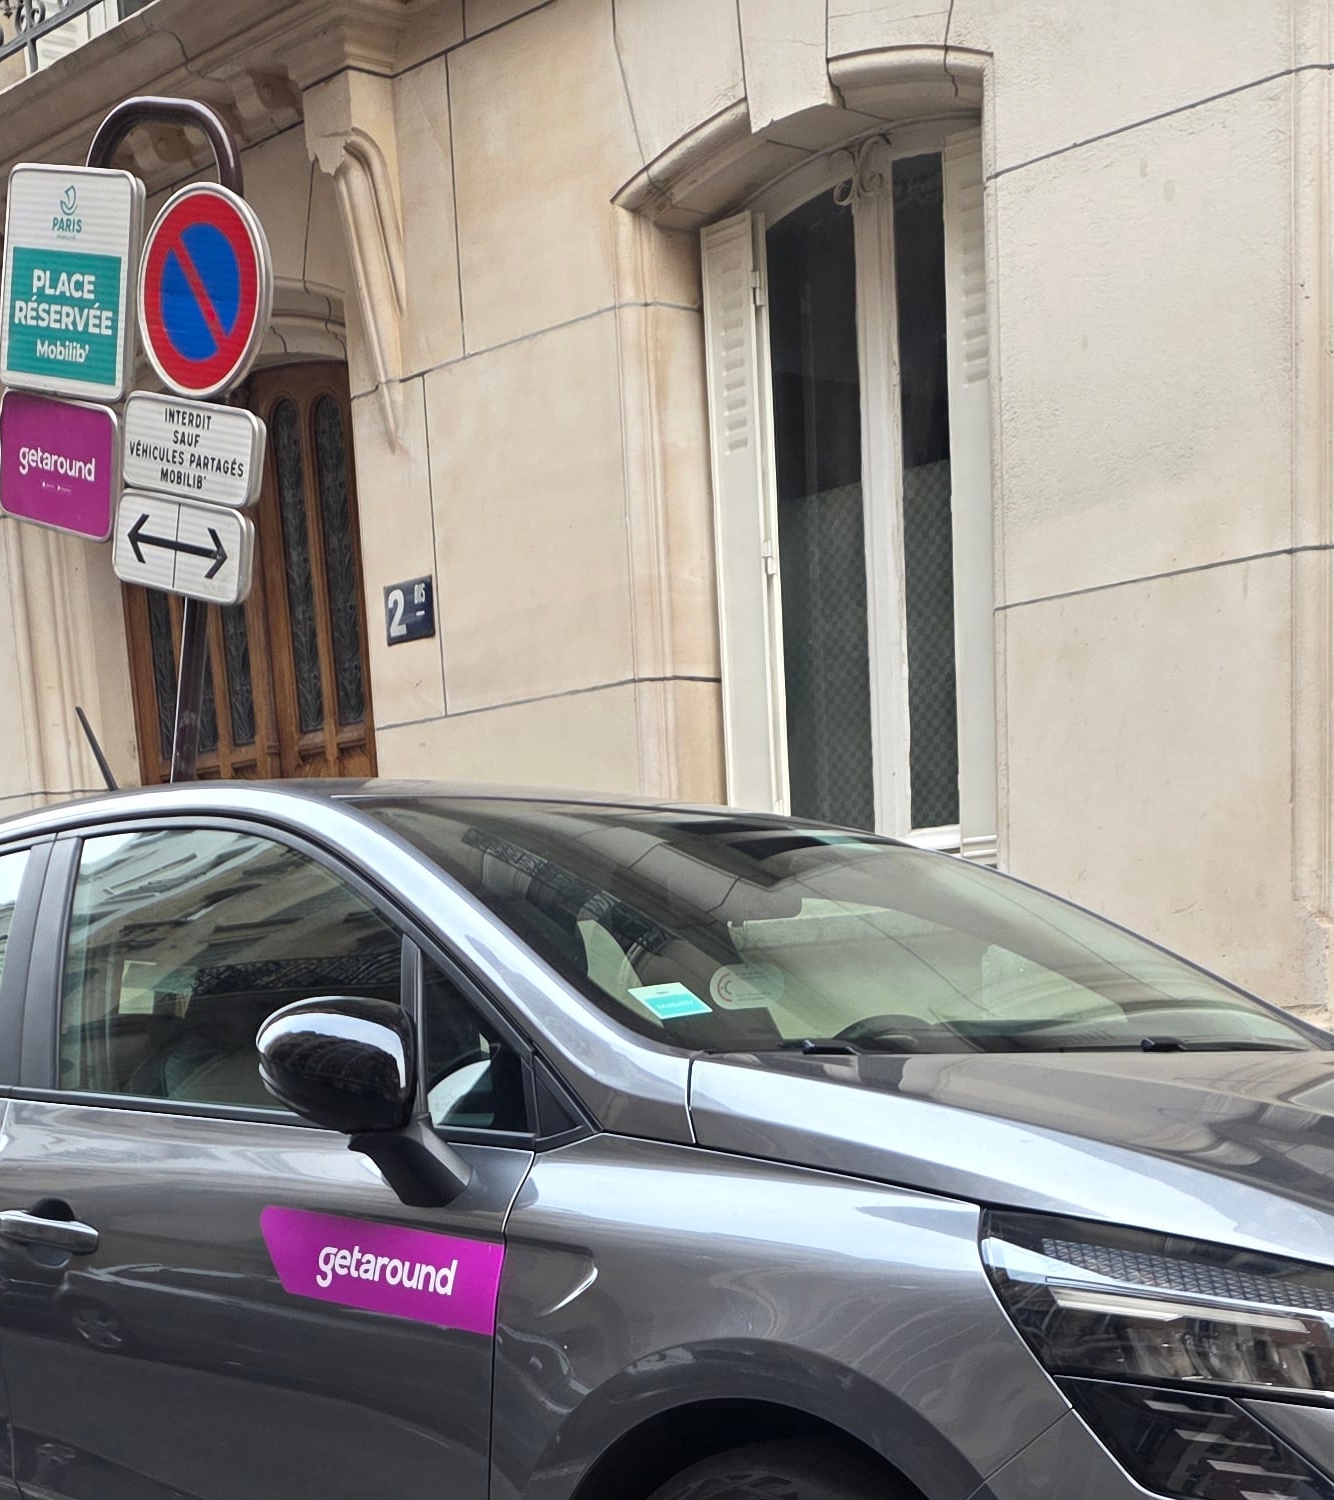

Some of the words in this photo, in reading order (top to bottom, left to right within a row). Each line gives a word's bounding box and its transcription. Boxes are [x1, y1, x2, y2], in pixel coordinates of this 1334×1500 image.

[52, 216, 83, 234] PARIS
[32, 268, 96, 300] PLACE
[14, 295, 113, 336] RÉSERVÉE
[164, 407, 212, 431] INTERDIT
[172, 429, 201, 448] SAUF
[19, 446, 96, 482] getaround
[129, 440, 185, 466] VÉHICULES
[189, 453, 244, 478] PARTAGÉS
[388, 588, 408, 638] 2
[316, 1245, 458, 1296] getaround
